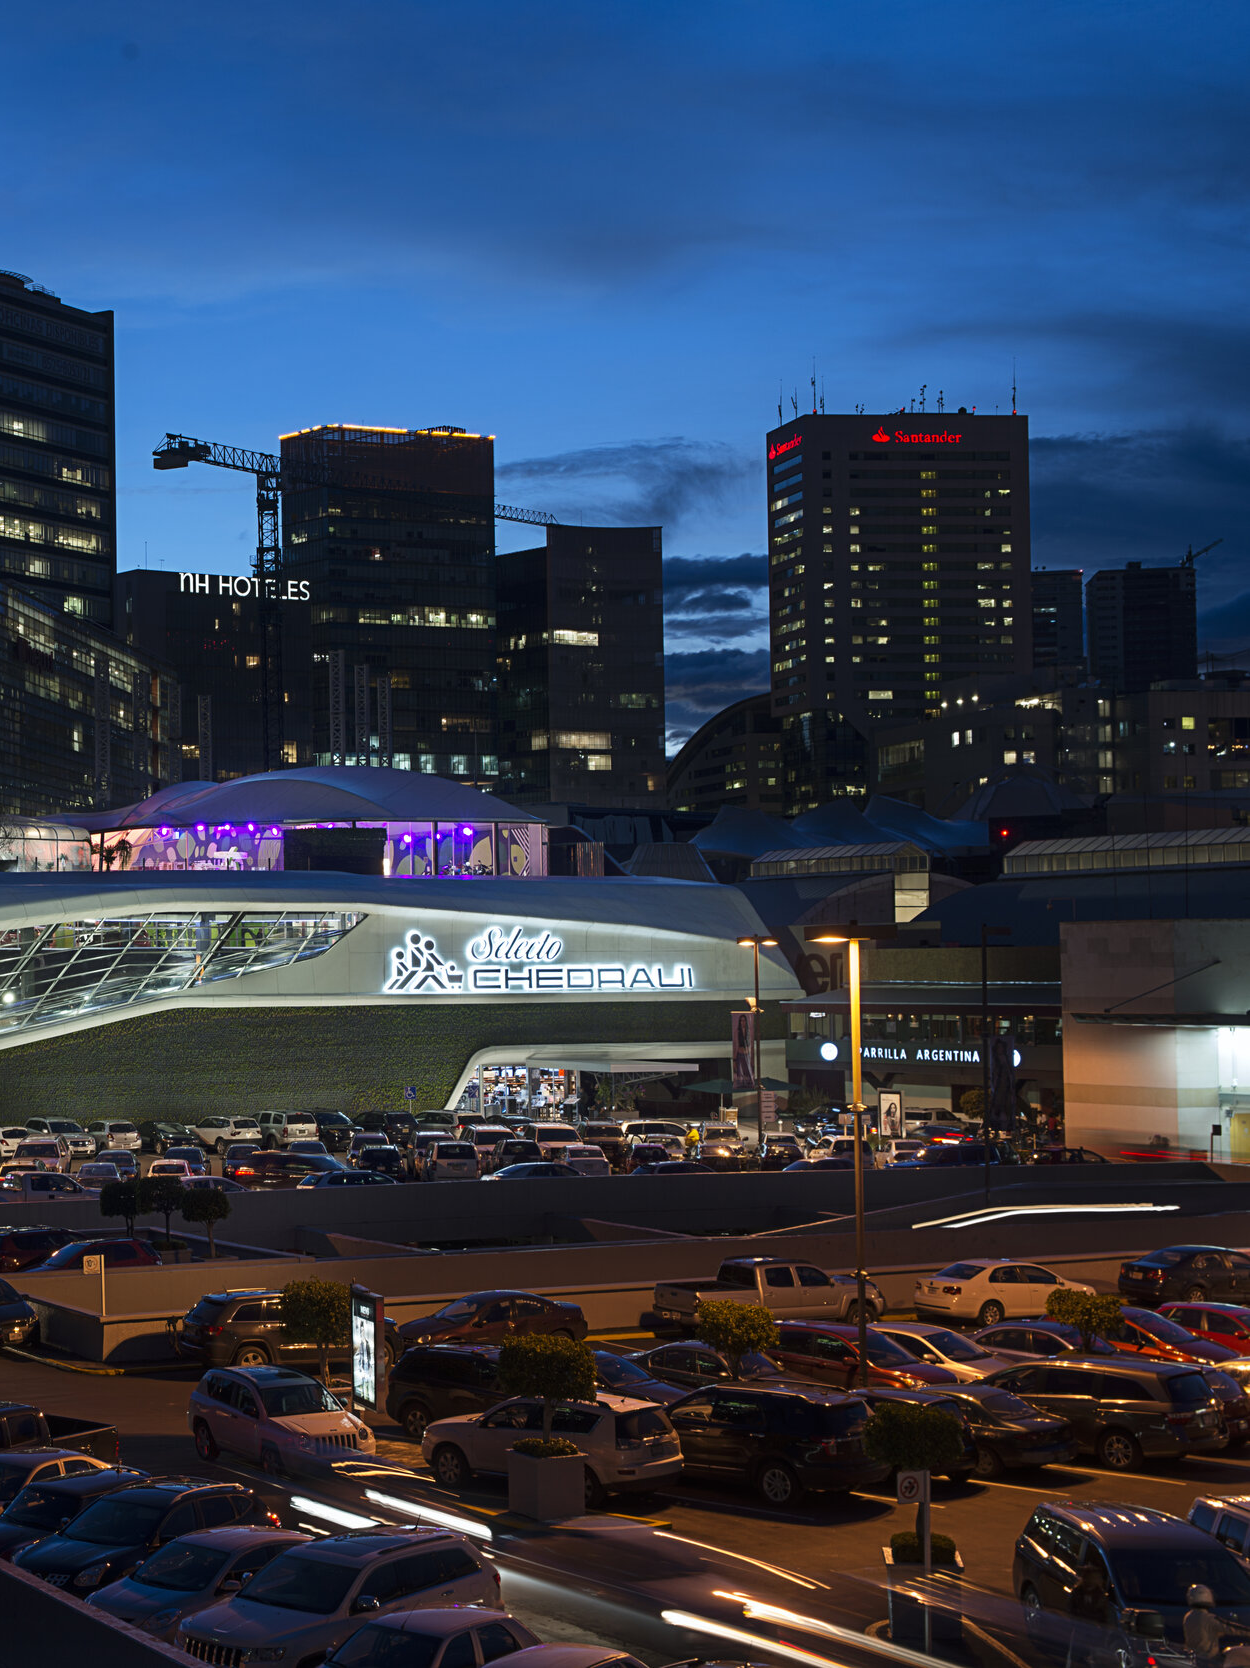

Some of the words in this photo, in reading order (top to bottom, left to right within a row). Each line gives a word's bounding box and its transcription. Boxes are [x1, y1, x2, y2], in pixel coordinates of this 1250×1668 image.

[776, 433, 802, 456] Santander
[895, 430, 962, 443] Santander
[470, 926, 564, 961] Selecto
[473, 967, 694, 989] CHEDRAUI
[916, 1048, 981, 1063] ARGENTINA
